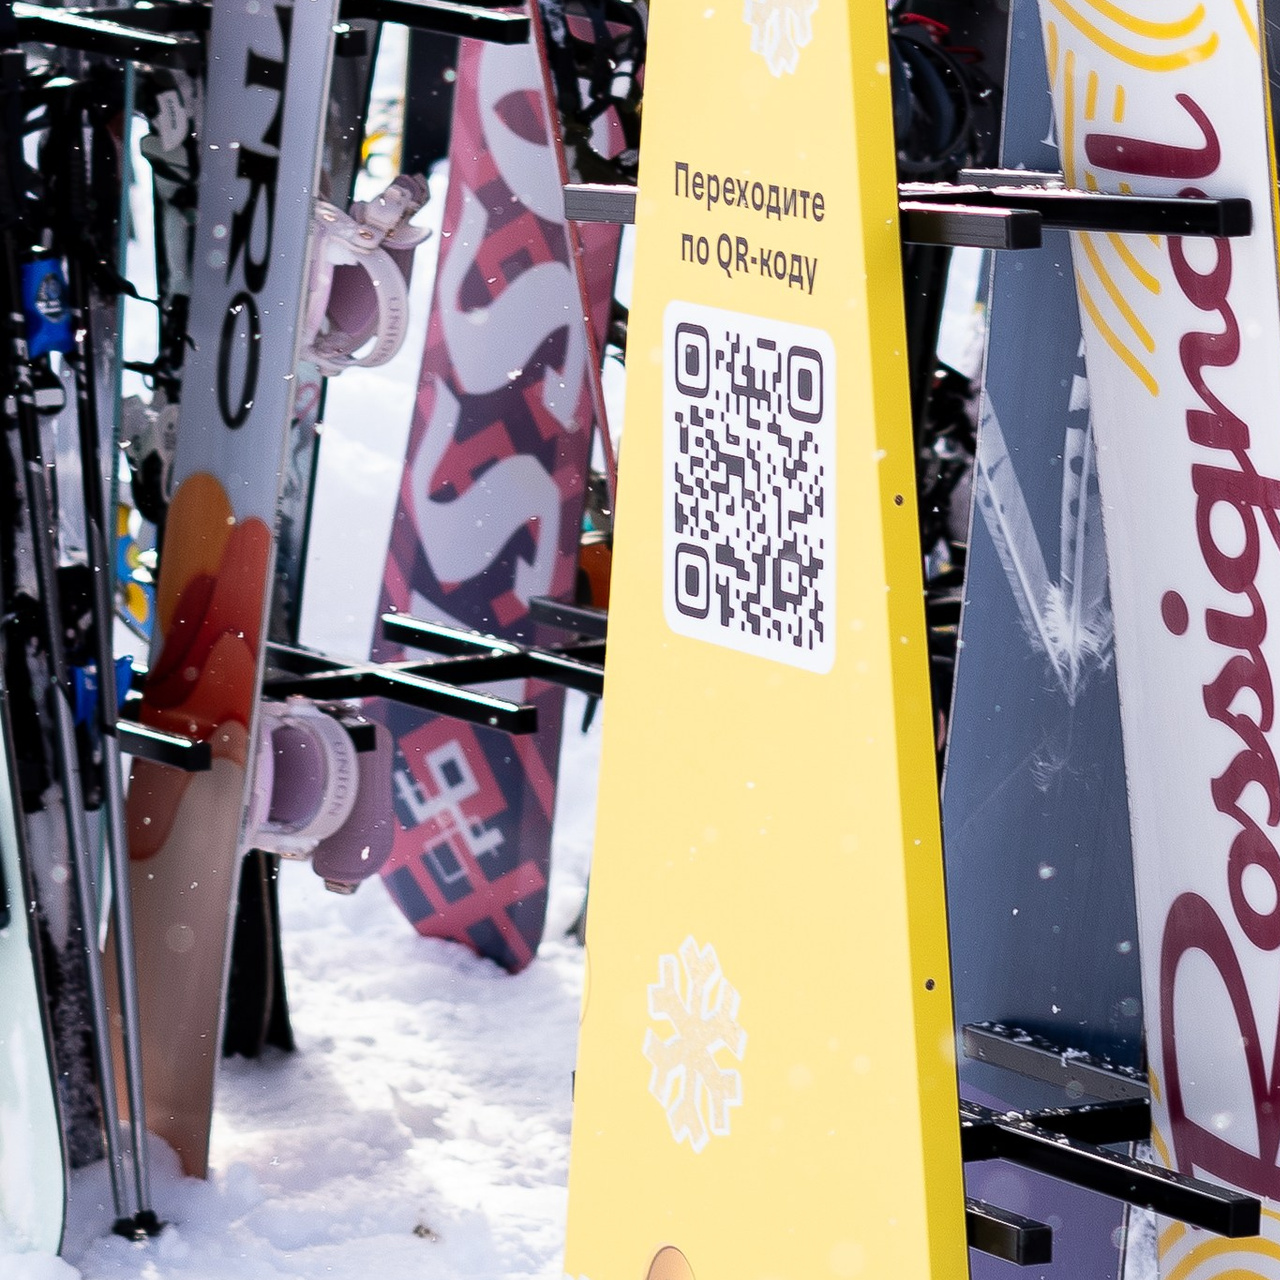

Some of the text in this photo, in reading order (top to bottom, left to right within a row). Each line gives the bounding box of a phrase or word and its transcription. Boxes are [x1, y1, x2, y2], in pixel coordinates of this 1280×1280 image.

[674, 160, 825, 223] Переходите
[681, 232, 818, 296] по QR-коду
